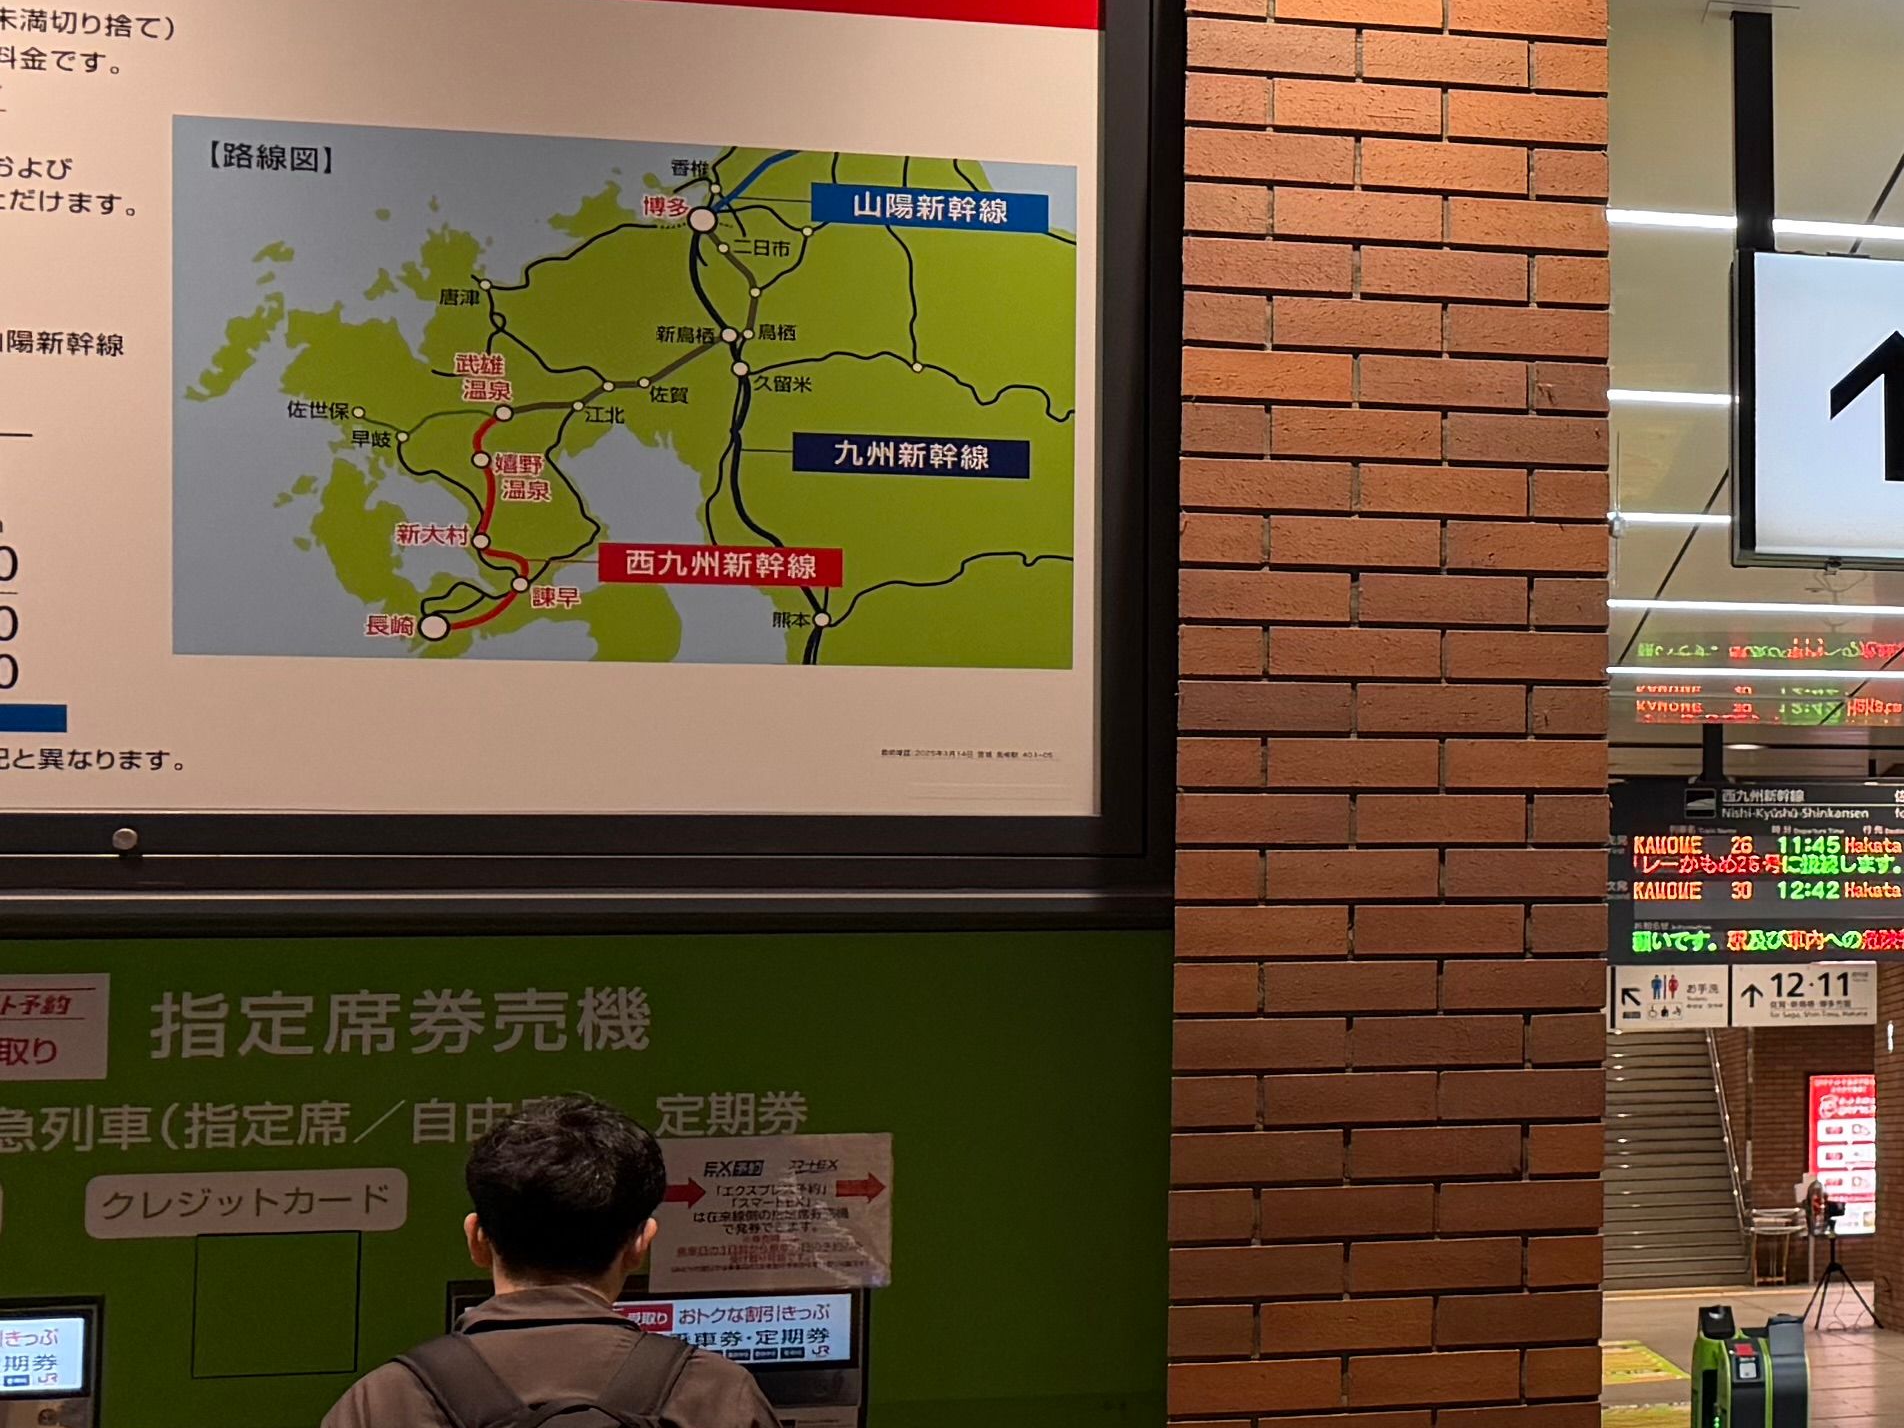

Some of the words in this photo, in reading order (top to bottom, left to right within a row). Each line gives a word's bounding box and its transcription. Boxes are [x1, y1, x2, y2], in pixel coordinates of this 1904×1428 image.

[211, 140, 332, 174] 【路線図】
[0, 189, 136, 217] だけます。
[642, 196, 690, 218] 博多
[853, 191, 1008, 223] 山陽新幹線
[733, 240, 791, 257] 二日市
[440, 289, 480, 306] 唐津
[0, 329, 125, 357] 陽新幹線
[656, 326, 715, 343] 新鳥栖
[758, 324, 797, 341] 鳥栖
[454, 354, 505, 376] 武雄
[463, 379, 513, 402] 温泉
[649, 386, 689, 404] 佐賀
[753, 376, 813, 394] 久留米
[287, 401, 349, 421] 佐世保
[584, 406, 625, 425] 江北
[351, 430, 392, 449] 早岐
[494, 453, 545, 475] 嬉野
[834, 440, 990, 471] 九州新幹線
[502, 480, 550, 501] 温泉
[395, 524, 470, 547] 新大村
[625, 549, 817, 580] 西九州新幹線
[531, 587, 581, 608] 諫早
[366, 615, 416, 637] 長崎
[772, 610, 810, 628] 熊本
[1731, 836, 1753, 854] 26
[1777, 835, 1841, 854] 11:45
[1844, 836, 1903, 854] Hakata
[1731, 881, 1753, 900] 30
[1777, 881, 1840, 900] 12:42
[1844, 881, 1903, 899] Hakata
[150, 985, 652, 1059] 指定席券売機
[655, 1090, 809, 1138] 定期券
[102, 1184, 389, 1221] クレジットカード
[678, 1303, 831, 1326] おトクな割引きっぷ
